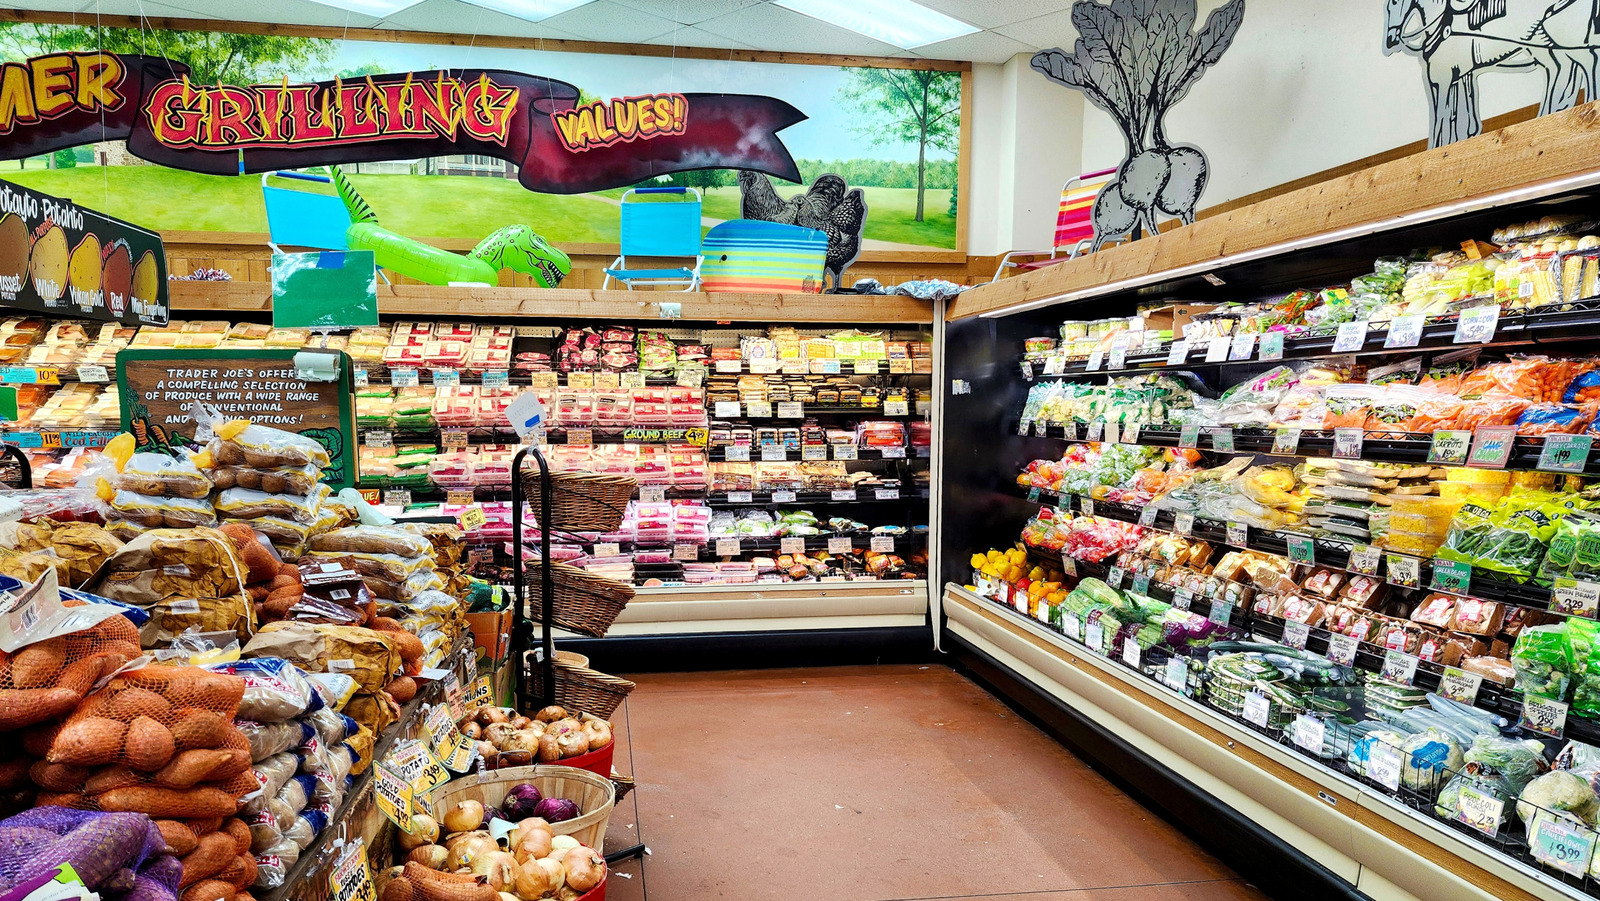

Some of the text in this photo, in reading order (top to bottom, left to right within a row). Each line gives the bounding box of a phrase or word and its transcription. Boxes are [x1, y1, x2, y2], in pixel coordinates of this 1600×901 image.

[143, 71, 520, 150] GRILLING
[552, 95, 688, 151] VALUES!
[0, 184, 84, 230] otayto Potahto
[0, 273, 22, 293] usset
[36, 278, 61, 298] White
[69, 285, 90, 305] Yukon
[90, 289, 105, 307] Gold
[110, 291, 124, 311] Red
[1463, 316, 1478, 326] CORN
[166, 368, 300, 379] TRADER JOE'S OFFER
[157, 380, 307, 390] A COMPELLING SELECTION
[145, 391, 319, 401] OF PRODUCE WITH A WIDE RANGE
[180, 403, 283, 411] OF CNVENTIONAL
[165, 415, 189, 424] AND
[250, 414, 304, 424] OPTIONS!
[65, 437, 86, 446] Cod
[624, 430, 660, 440] GROUND
[663, 430, 684, 439] BEEF
[1436, 440, 1463, 449] CARROTS
[1435, 566, 1468, 577] GREEN BEANS
[1556, 588, 1597, 601] GREEN BEANS
[464, 686, 488, 703] NIONS
[1528, 700, 1565, 715] BRUSSELS
[400, 757, 431, 776] POTATO
[382, 778, 399, 794] GOLD
[376, 781, 407, 810] POTATOES
[1463, 791, 1496, 812] BROCCOLI
[1541, 829, 1587, 853] CAULIFLOWER
[338, 864, 365, 901] POTATOES
